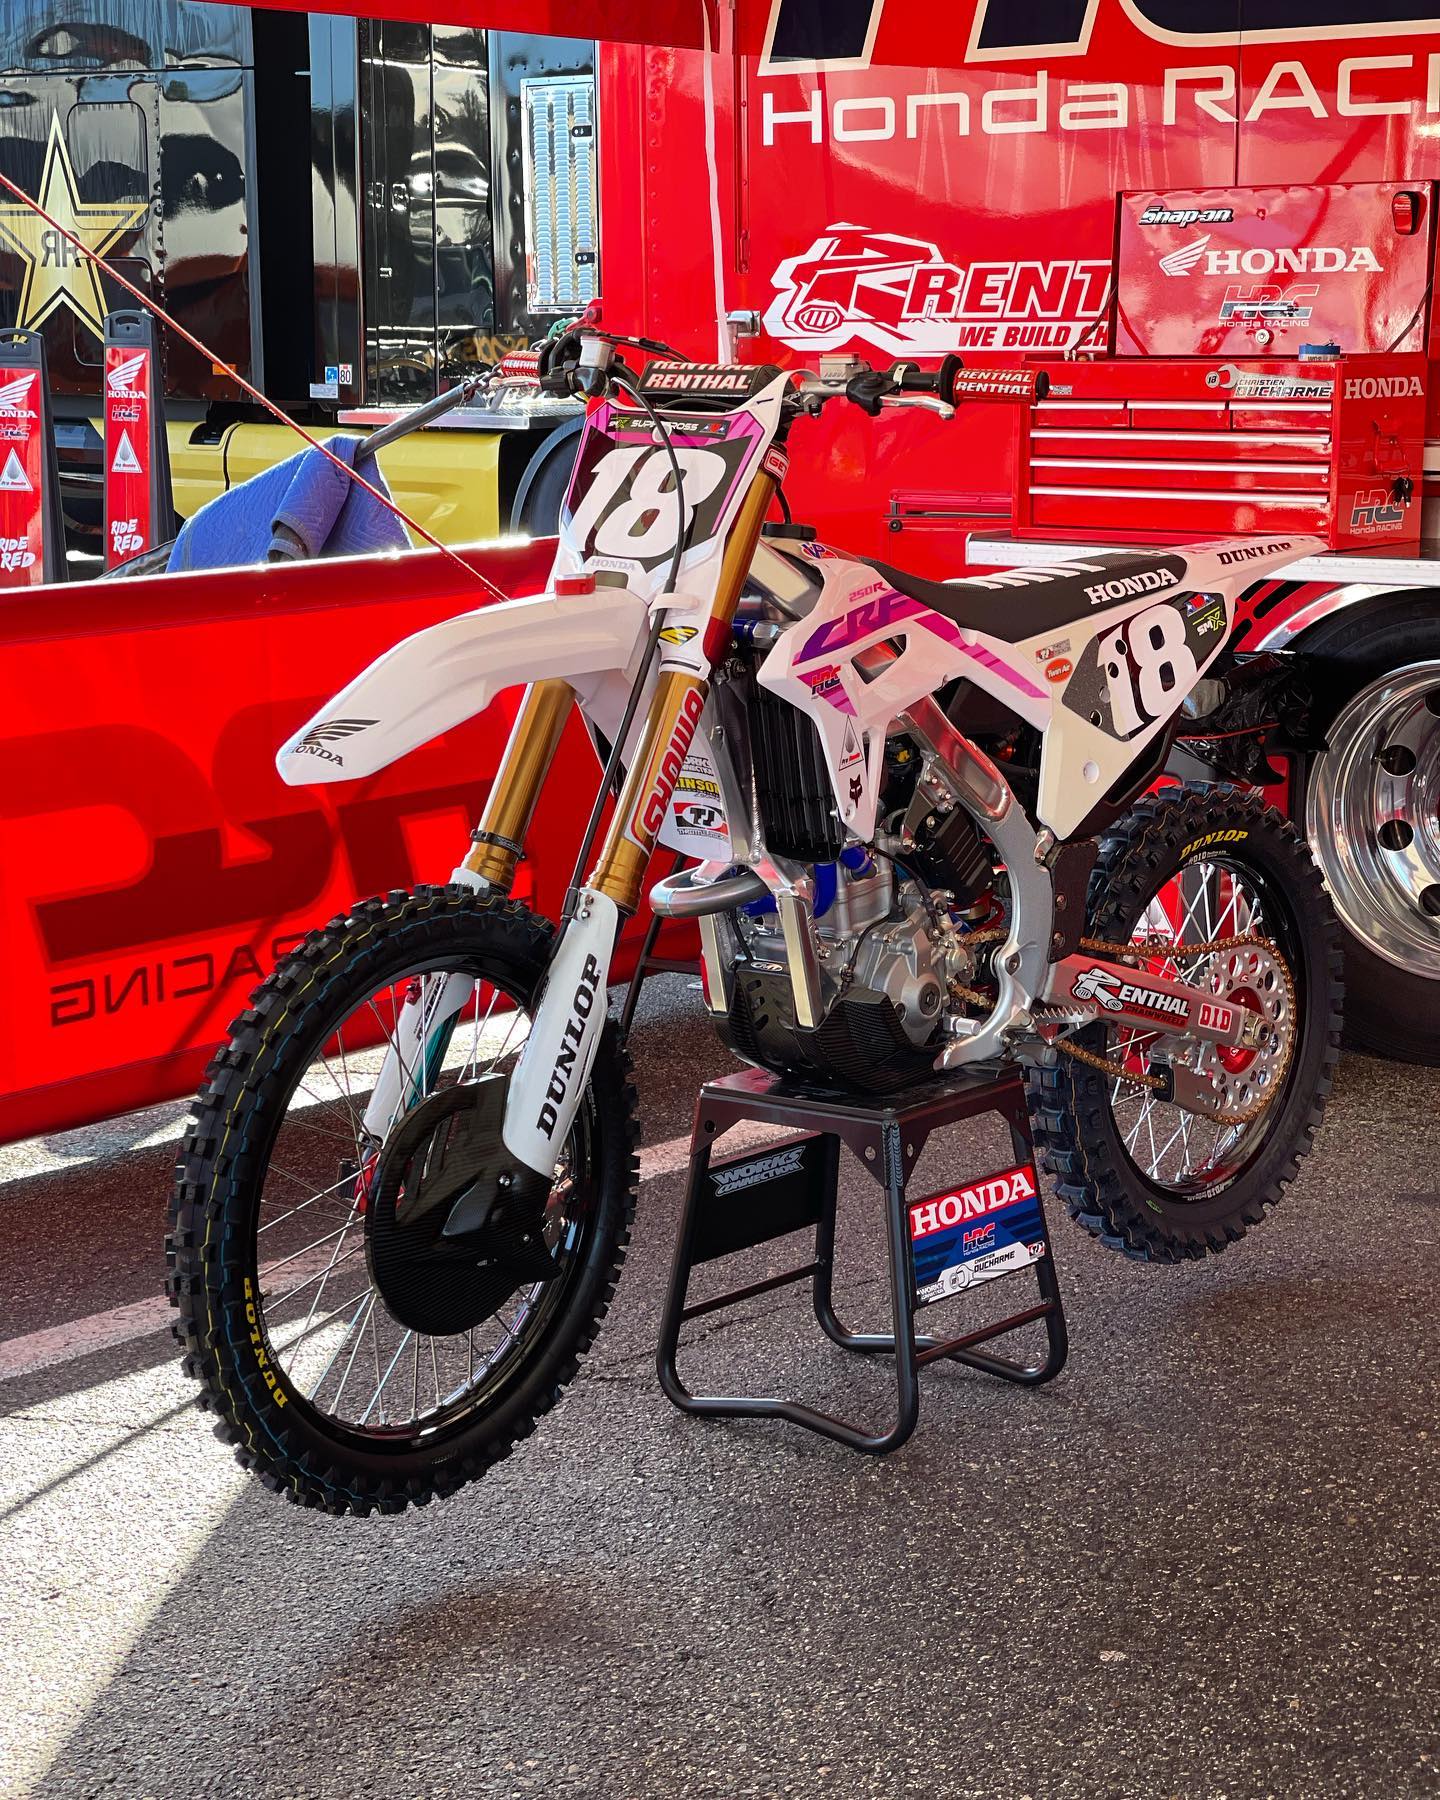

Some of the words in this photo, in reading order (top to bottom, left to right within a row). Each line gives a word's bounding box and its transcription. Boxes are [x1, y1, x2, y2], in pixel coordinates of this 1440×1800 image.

[763, 70, 1128, 146] Honda
[1139, 207, 1232, 227] Snap-on
[1203, 247, 1383, 275] HONDA
[958, 326, 997, 347] WE
[1003, 325, 1072, 347] BUILD
[340, 370, 351, 383] 80
[645, 373, 750, 390] RENTHAL
[958, 370, 1032, 383] RENTHAL
[1344, 376, 1424, 399] HONDA
[108, 391, 149, 400] HONDA
[955, 381, 1031, 395] RENTHAL
[1234, 386, 1333, 397] DUCHARME
[564, 446, 726, 558] 18
[111, 519, 138, 536] RIDE
[1350, 526, 1376, 535] Honda
[1376, 523, 1403, 532] RACING
[113, 534, 144, 556] RED
[1, 551, 36, 572] RED
[591, 558, 636, 570] HONDA
[849, 581, 888, 602] 250R
[1084, 568, 1179, 605] HONDA
[1197, 611, 1226, 636] SMX
[1097, 604, 1198, 737] 18
[643, 688, 704, 837] SHOWA
[1179, 829, 1249, 862] DUNLOP
[536, 953, 600, 1141] DUNLOP
[714, 1148, 803, 1185] WORKS
[717, 1162, 800, 1195] CONNECTION
[911, 1172, 1034, 1237] HONDA
[963, 1222, 995, 1252] HRC
[973, 1251, 1015, 1273] DUCHARME
[244, 1277, 288, 1408] DUNLOP
